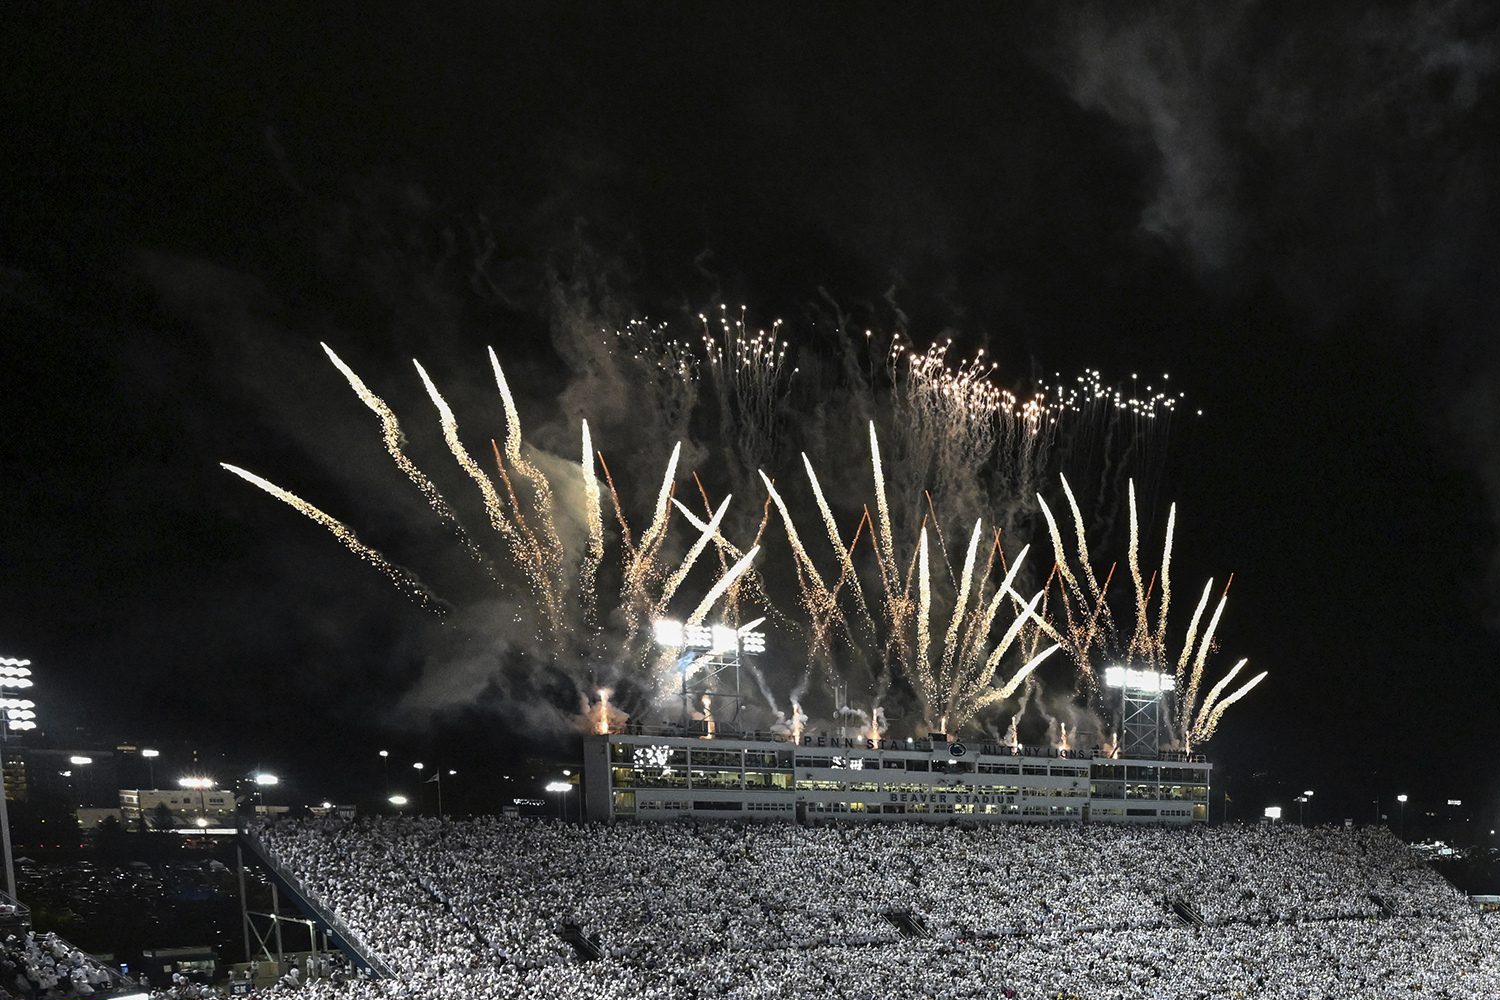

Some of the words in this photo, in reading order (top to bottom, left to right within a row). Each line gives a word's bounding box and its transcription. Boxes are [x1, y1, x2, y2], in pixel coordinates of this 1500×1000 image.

[804, 736, 854, 748] PENN
[866, 739, 922, 750] STATE
[983, 745, 1040, 756] NITTANY
[1048, 748, 1085, 759] LIONS
[890, 793, 947, 803] BEAVER
[955, 794, 1015, 804] STADIUM
